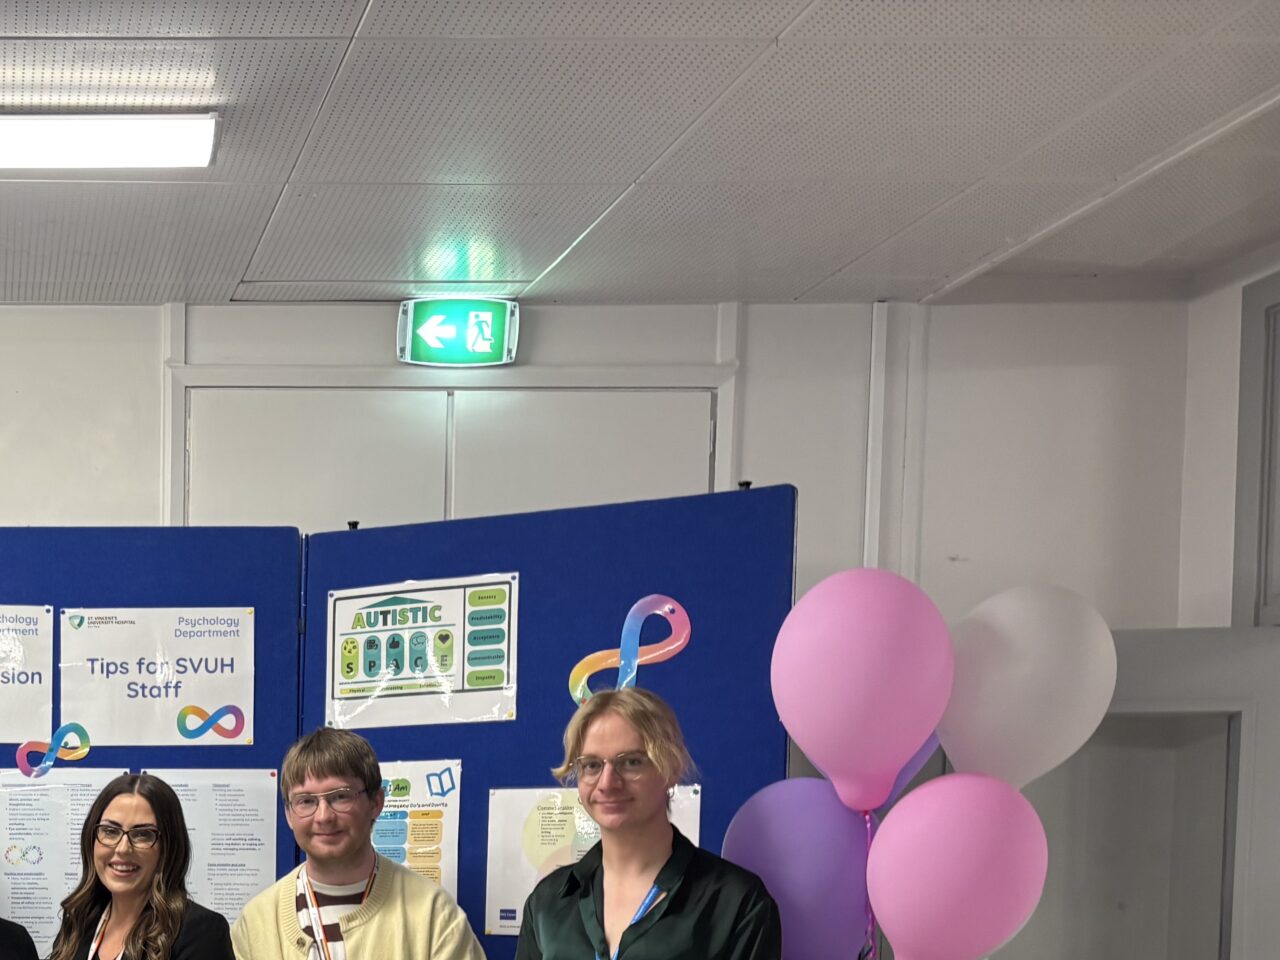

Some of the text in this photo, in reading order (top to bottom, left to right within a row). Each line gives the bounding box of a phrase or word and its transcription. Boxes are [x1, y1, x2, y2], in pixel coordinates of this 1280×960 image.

[178, 616, 240, 628] Psychology
[351, 605, 442, 629] AUTISTIC
[174, 628, 240, 640] Department
[86, 657, 235, 679] Tips for SVUH
[346, 662, 354, 674] S
[368, 660, 376, 672] P
[127, 681, 182, 699] Staff
[393, 784, 408, 792] Am
